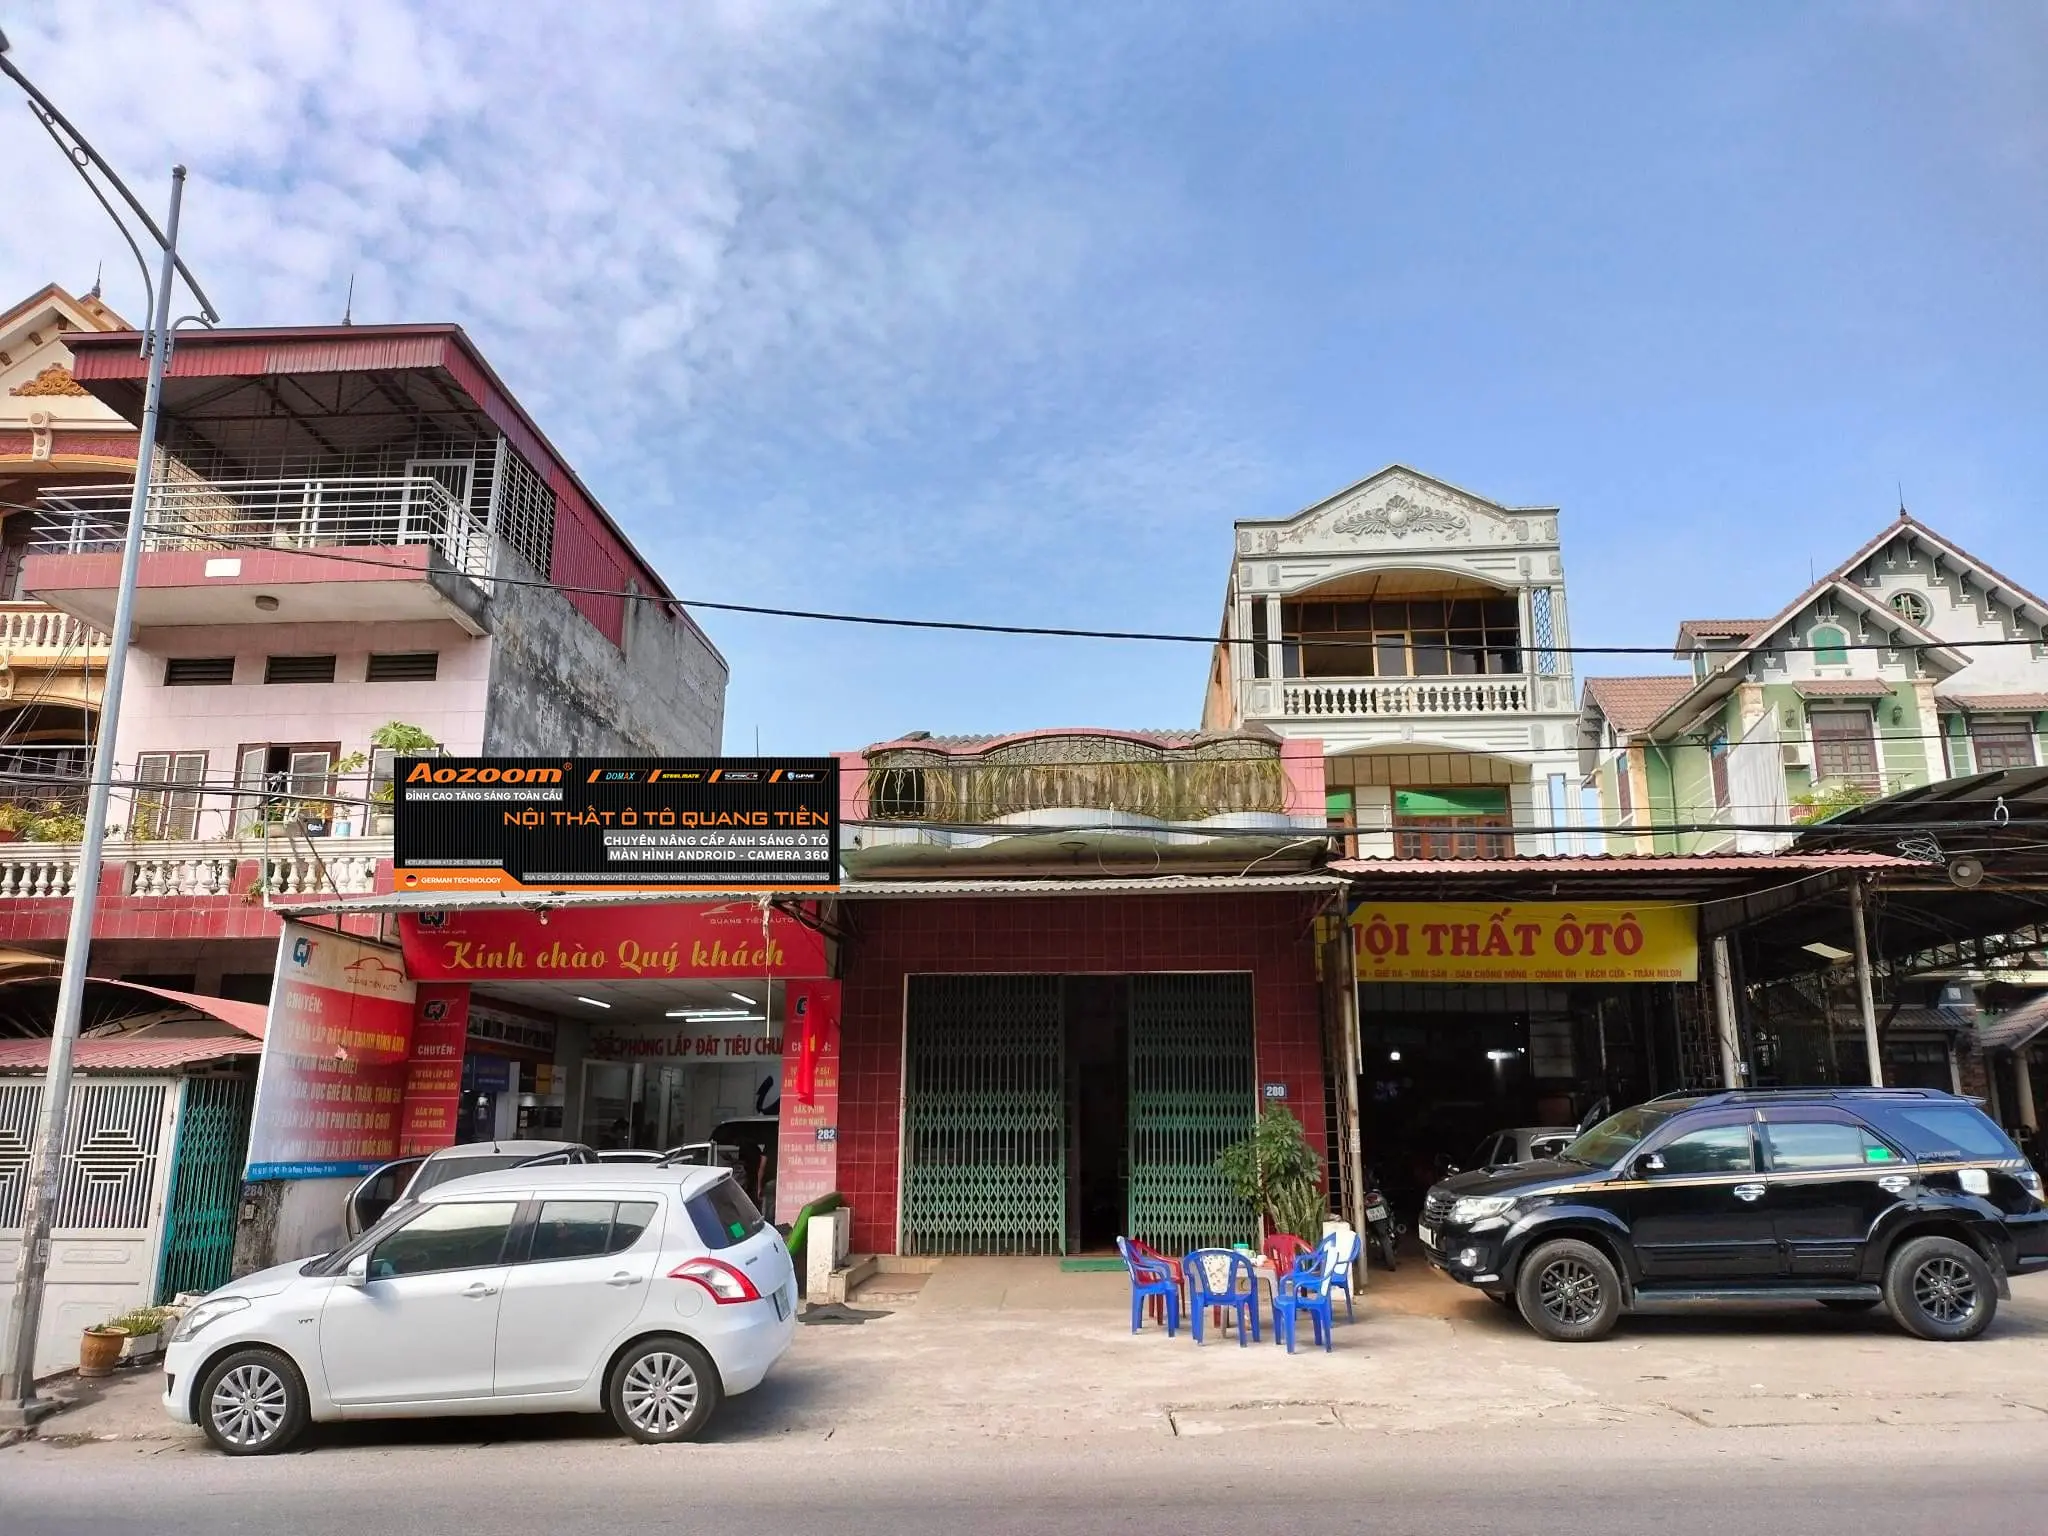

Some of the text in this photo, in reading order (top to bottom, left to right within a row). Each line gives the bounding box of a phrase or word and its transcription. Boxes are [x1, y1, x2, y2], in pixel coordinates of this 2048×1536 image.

[406, 763, 562, 783] Aozoom
[605, 772, 635, 780] DOMAX
[406, 788, 563, 801] ĐỈNH CAO TĂNG SÁNG TOÀN CẦU
[504, 804, 829, 830] NỘI THẤT Ô TÔ QUANG TIẾN
[604, 832, 829, 846] CHUYÊN NÂNG CẤP ÁNH SÁNG Ô TÔ
[610, 847, 638, 860] MÀN
[643, 847, 673, 860] HÌNH
[678, 850, 736, 860] ANDROID
[748, 850, 801, 860] CAMERA
[805, 850, 829, 860] 360
[1421, 907, 1541, 956] THẤT
[1554, 912, 1643, 956] ÔTÔ
[442, 940, 785, 975] Kính chào Quý khách
[417, 1043, 456, 1056] CHUYÊN:
[667, 1031, 690, 1056] LẮP
[695, 1034, 720, 1057] ĐẶT
[724, 1034, 751, 1056] TIÊU
[818, 1129, 835, 1140] 282
[244, 1185, 263, 1197] 284
